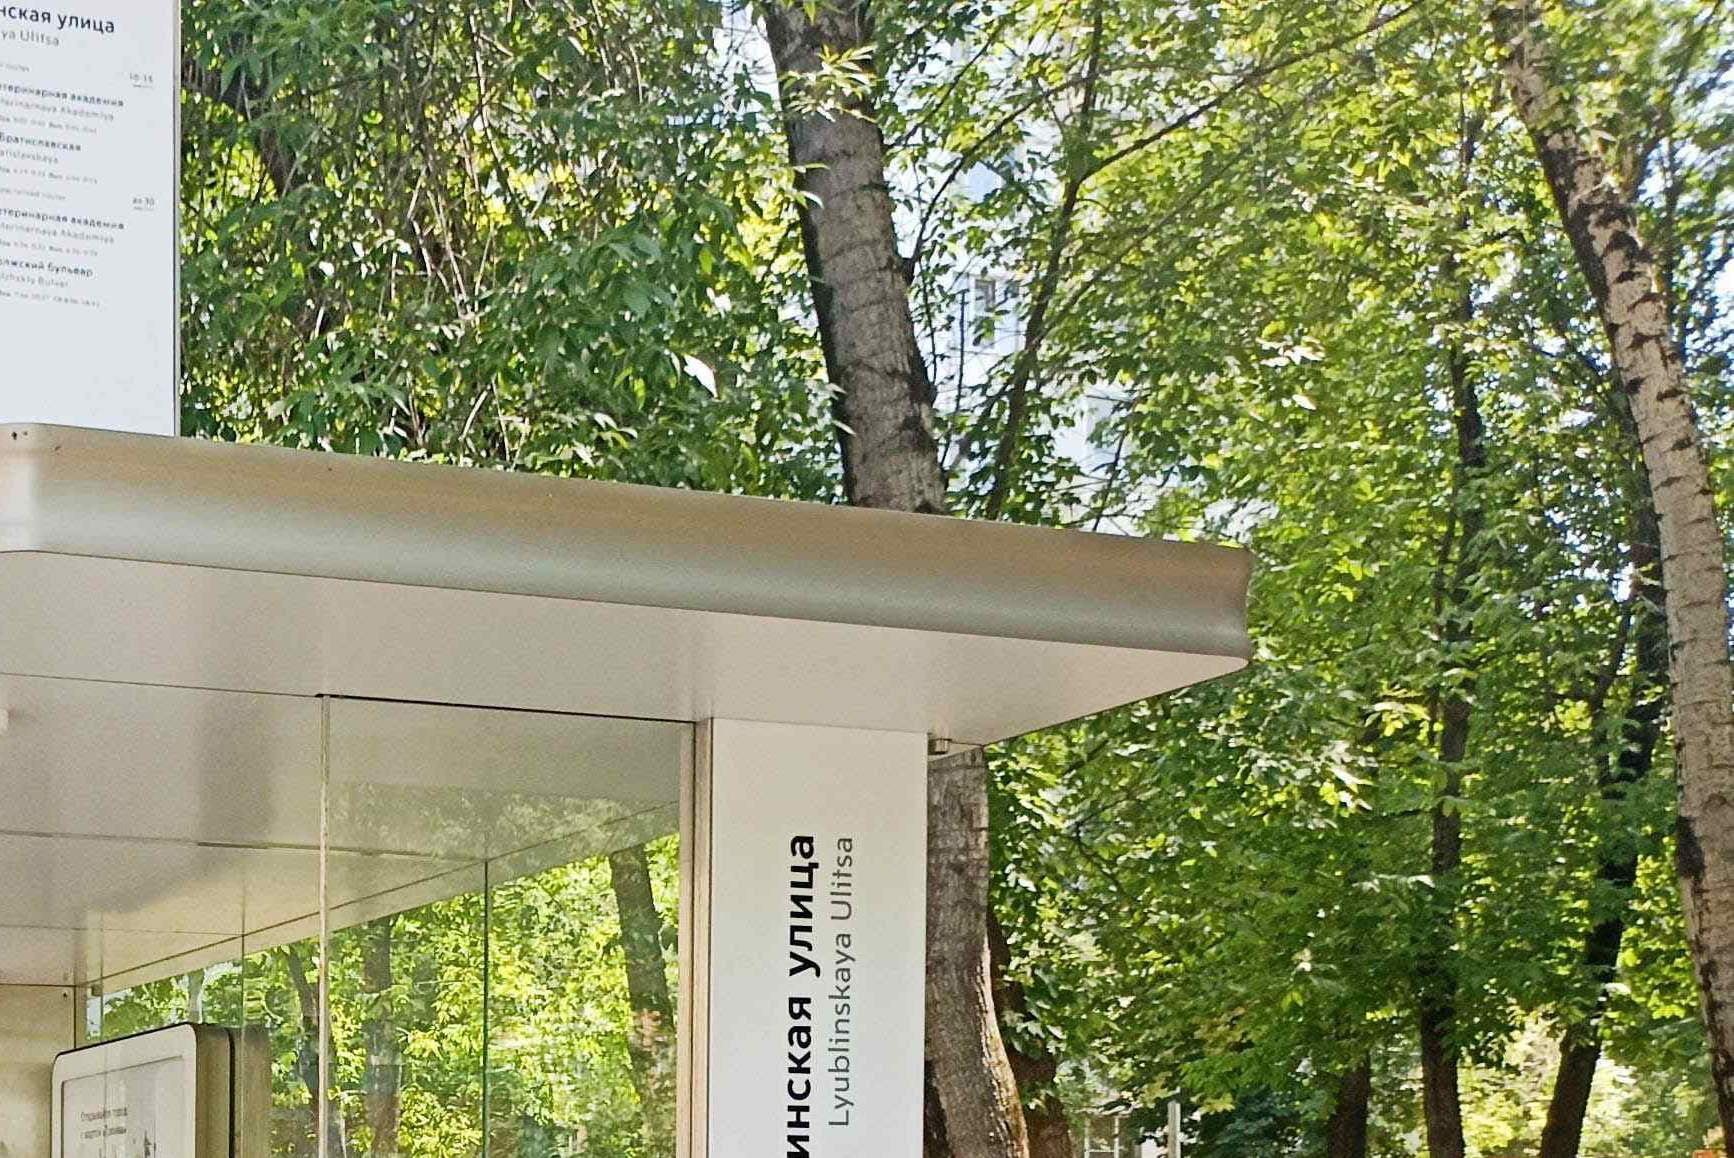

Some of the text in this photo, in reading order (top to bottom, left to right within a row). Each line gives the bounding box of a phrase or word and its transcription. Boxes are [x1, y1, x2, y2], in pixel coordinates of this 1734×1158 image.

[20, 30, 60, 46] Ulitsa
[57, 13, 115, 34] улица
[788, 834, 821, 978] улица
[828, 836, 857, 1127] Lyublinskaya Ulitsa
